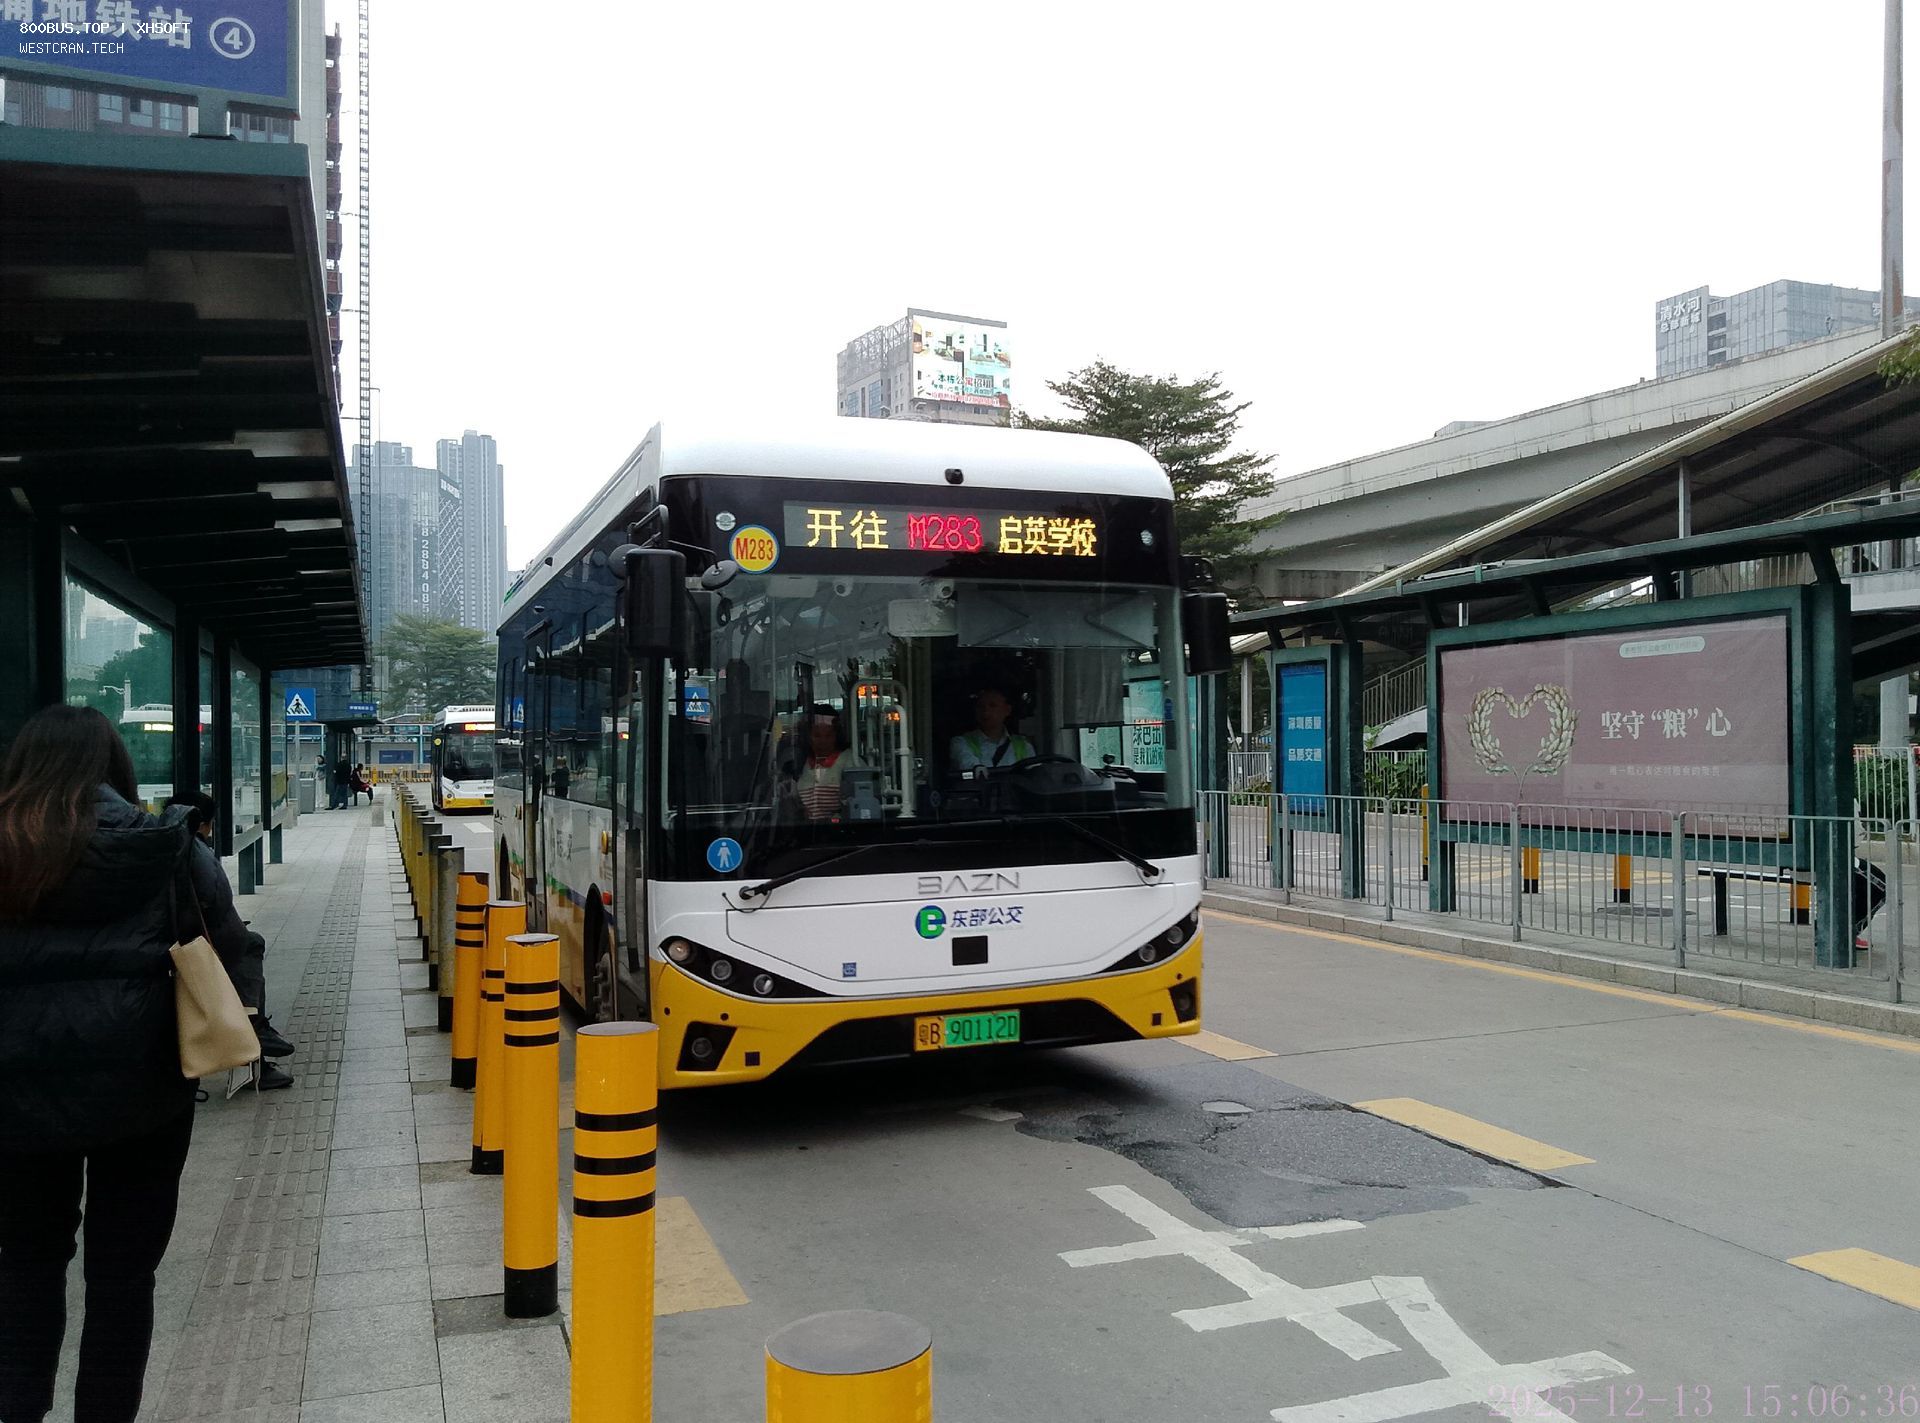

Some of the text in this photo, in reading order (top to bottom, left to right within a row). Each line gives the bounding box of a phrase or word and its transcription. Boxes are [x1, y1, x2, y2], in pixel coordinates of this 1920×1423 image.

[806, 508, 1097, 557] 开往 M283 启英学校
[735, 537, 774, 563] M283
[918, 872, 1020, 895] BAZN
[951, 906, 1024, 928] 东部公交
